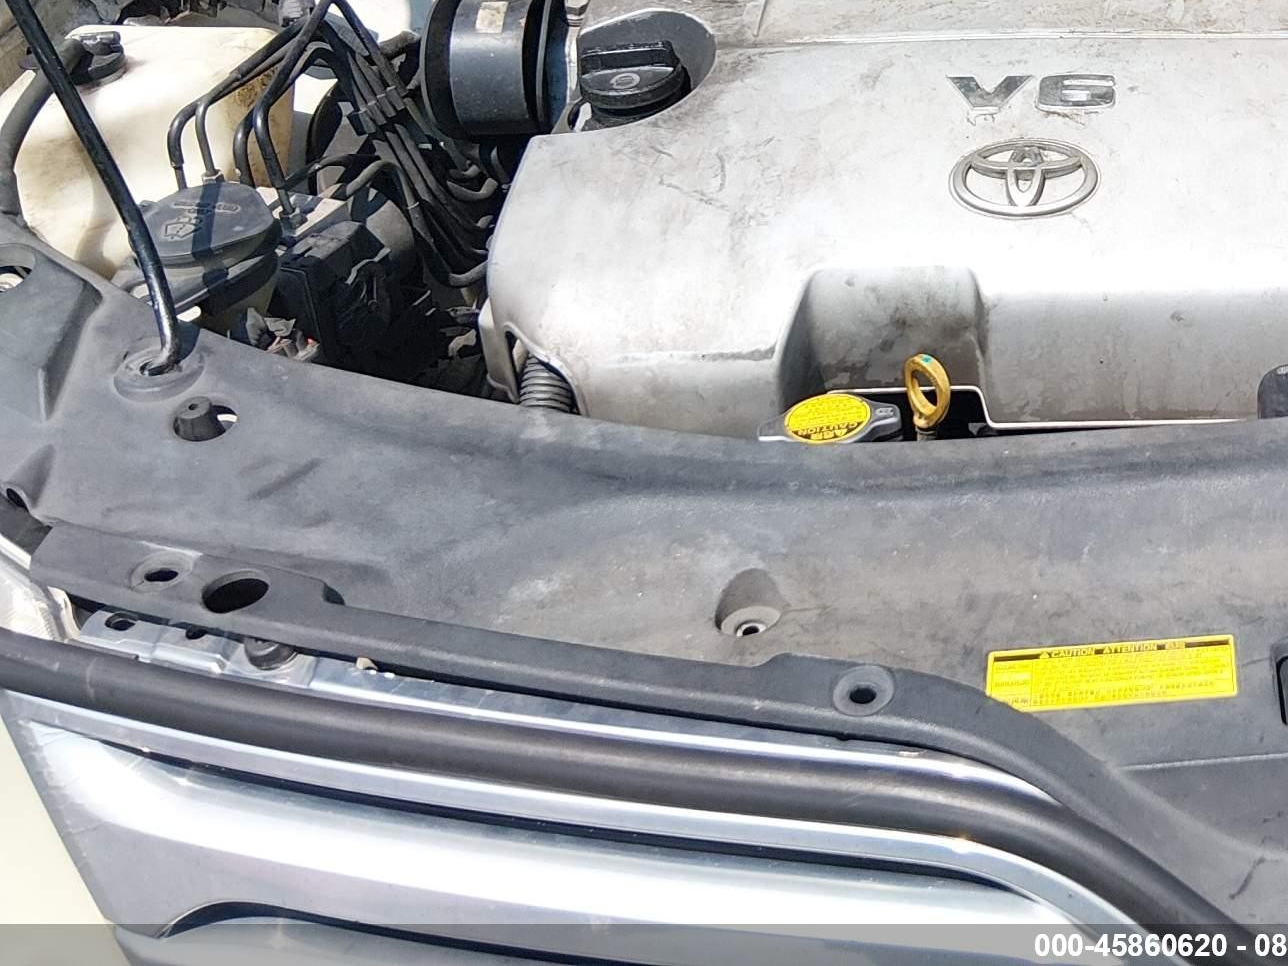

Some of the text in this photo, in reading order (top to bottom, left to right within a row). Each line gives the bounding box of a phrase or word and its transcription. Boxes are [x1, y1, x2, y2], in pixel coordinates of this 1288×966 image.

[946, 74, 1116, 112] V6
[797, 421, 858, 436] CAUTION
[1051, 647, 1096, 659] CAUTION
[1103, 642, 1158, 655] ATTENTION
